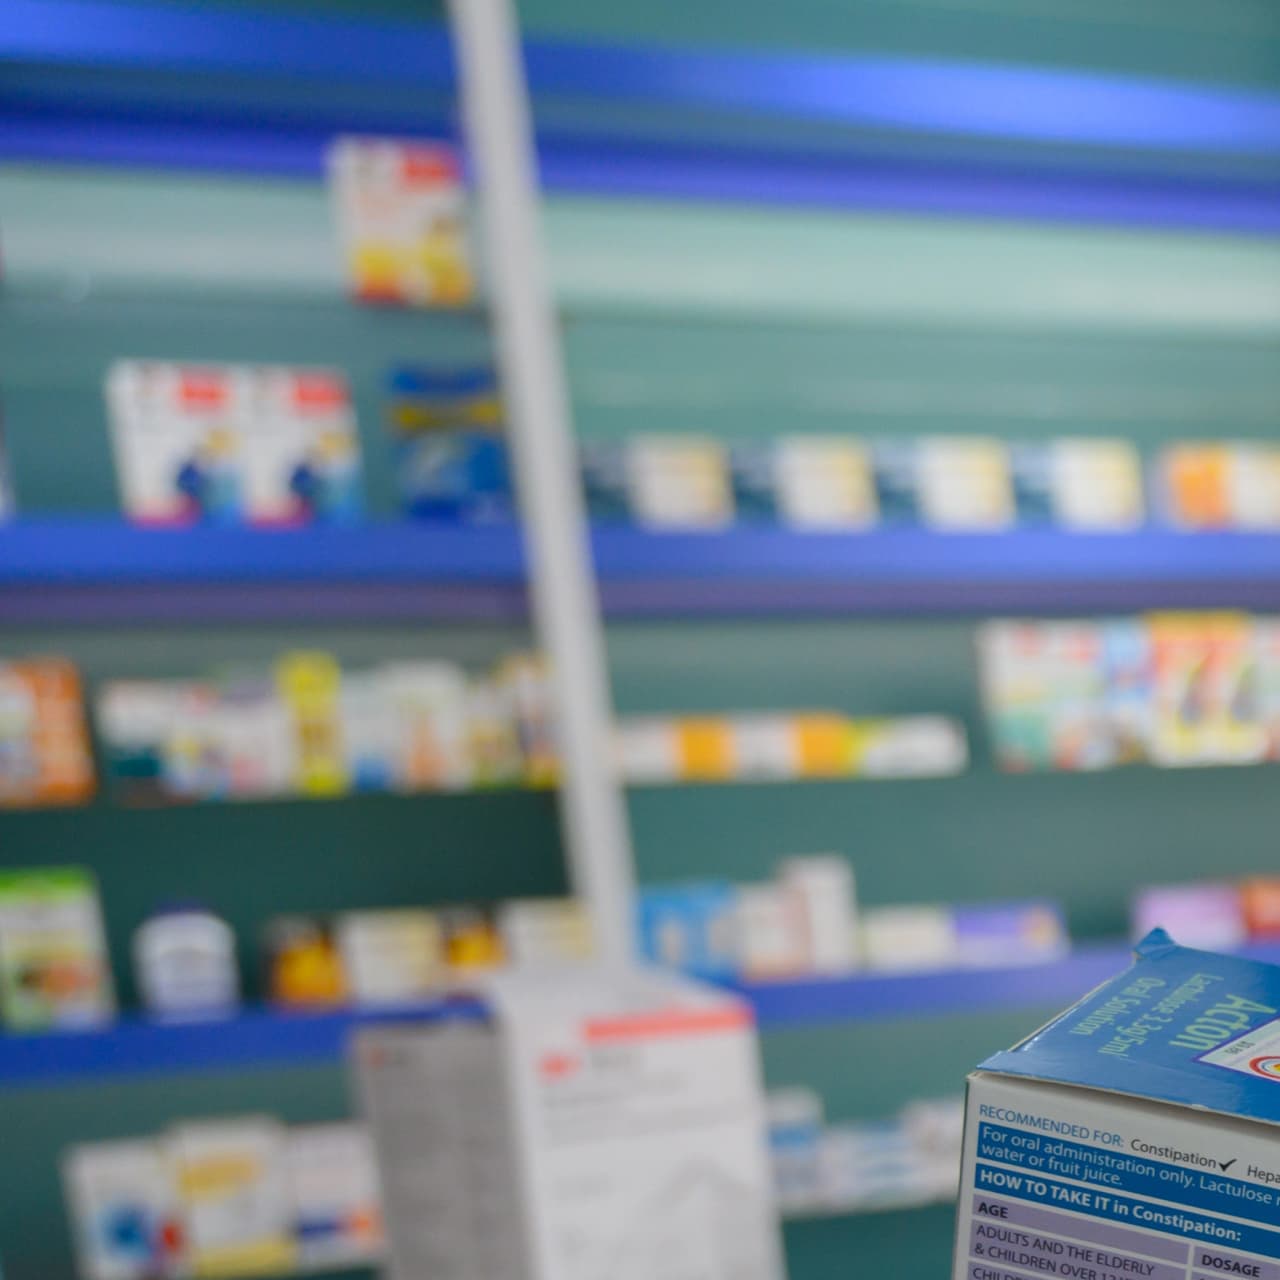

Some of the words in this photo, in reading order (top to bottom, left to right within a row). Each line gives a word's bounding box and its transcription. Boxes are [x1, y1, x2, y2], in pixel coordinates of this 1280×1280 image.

[1070, 995, 1139, 1036] Solution
[1169, 994, 1277, 1050] Acton
[979, 1103, 1090, 1140] RECOMMENDED
[1093, 1129, 1124, 1148] FOR:
[1131, 1137, 1216, 1168] Constipation
[982, 1143, 1024, 1163] water
[1028, 1154, 1044, 1167] or
[1048, 1155, 1080, 1176] fruit
[1082, 1163, 1123, 1186] juice.
[983, 1125, 1007, 1142] For
[1011, 1134, 1040, 1150] oral
[1044, 1141, 1155, 1177] administration
[1159, 1169, 1195, 1188] only.
[1200, 1175, 1272, 1204] Lactulose
[978, 1200, 1009, 1219] AGE
[980, 1168, 1022, 1190] HOW
[1025, 1179, 1048, 1196] TO
[1050, 1185, 1091, 1206] TAKE
[1095, 1195, 1111, 1211] IT
[1113, 1200, 1129, 1215] in
[1132, 1204, 1242, 1241] Constipation:
[974, 1242, 985, 1256] &
[988, 1245, 1057, 1273] CHILDREN
[976, 1224, 1030, 1248] ADULTS
[1033, 1237, 1064, 1256] AND
[1067, 1245, 1092, 1262] THE
[1096, 1252, 1154, 1277] ELDERLY
[1202, 1253, 1261, 1278] DOSAGE
